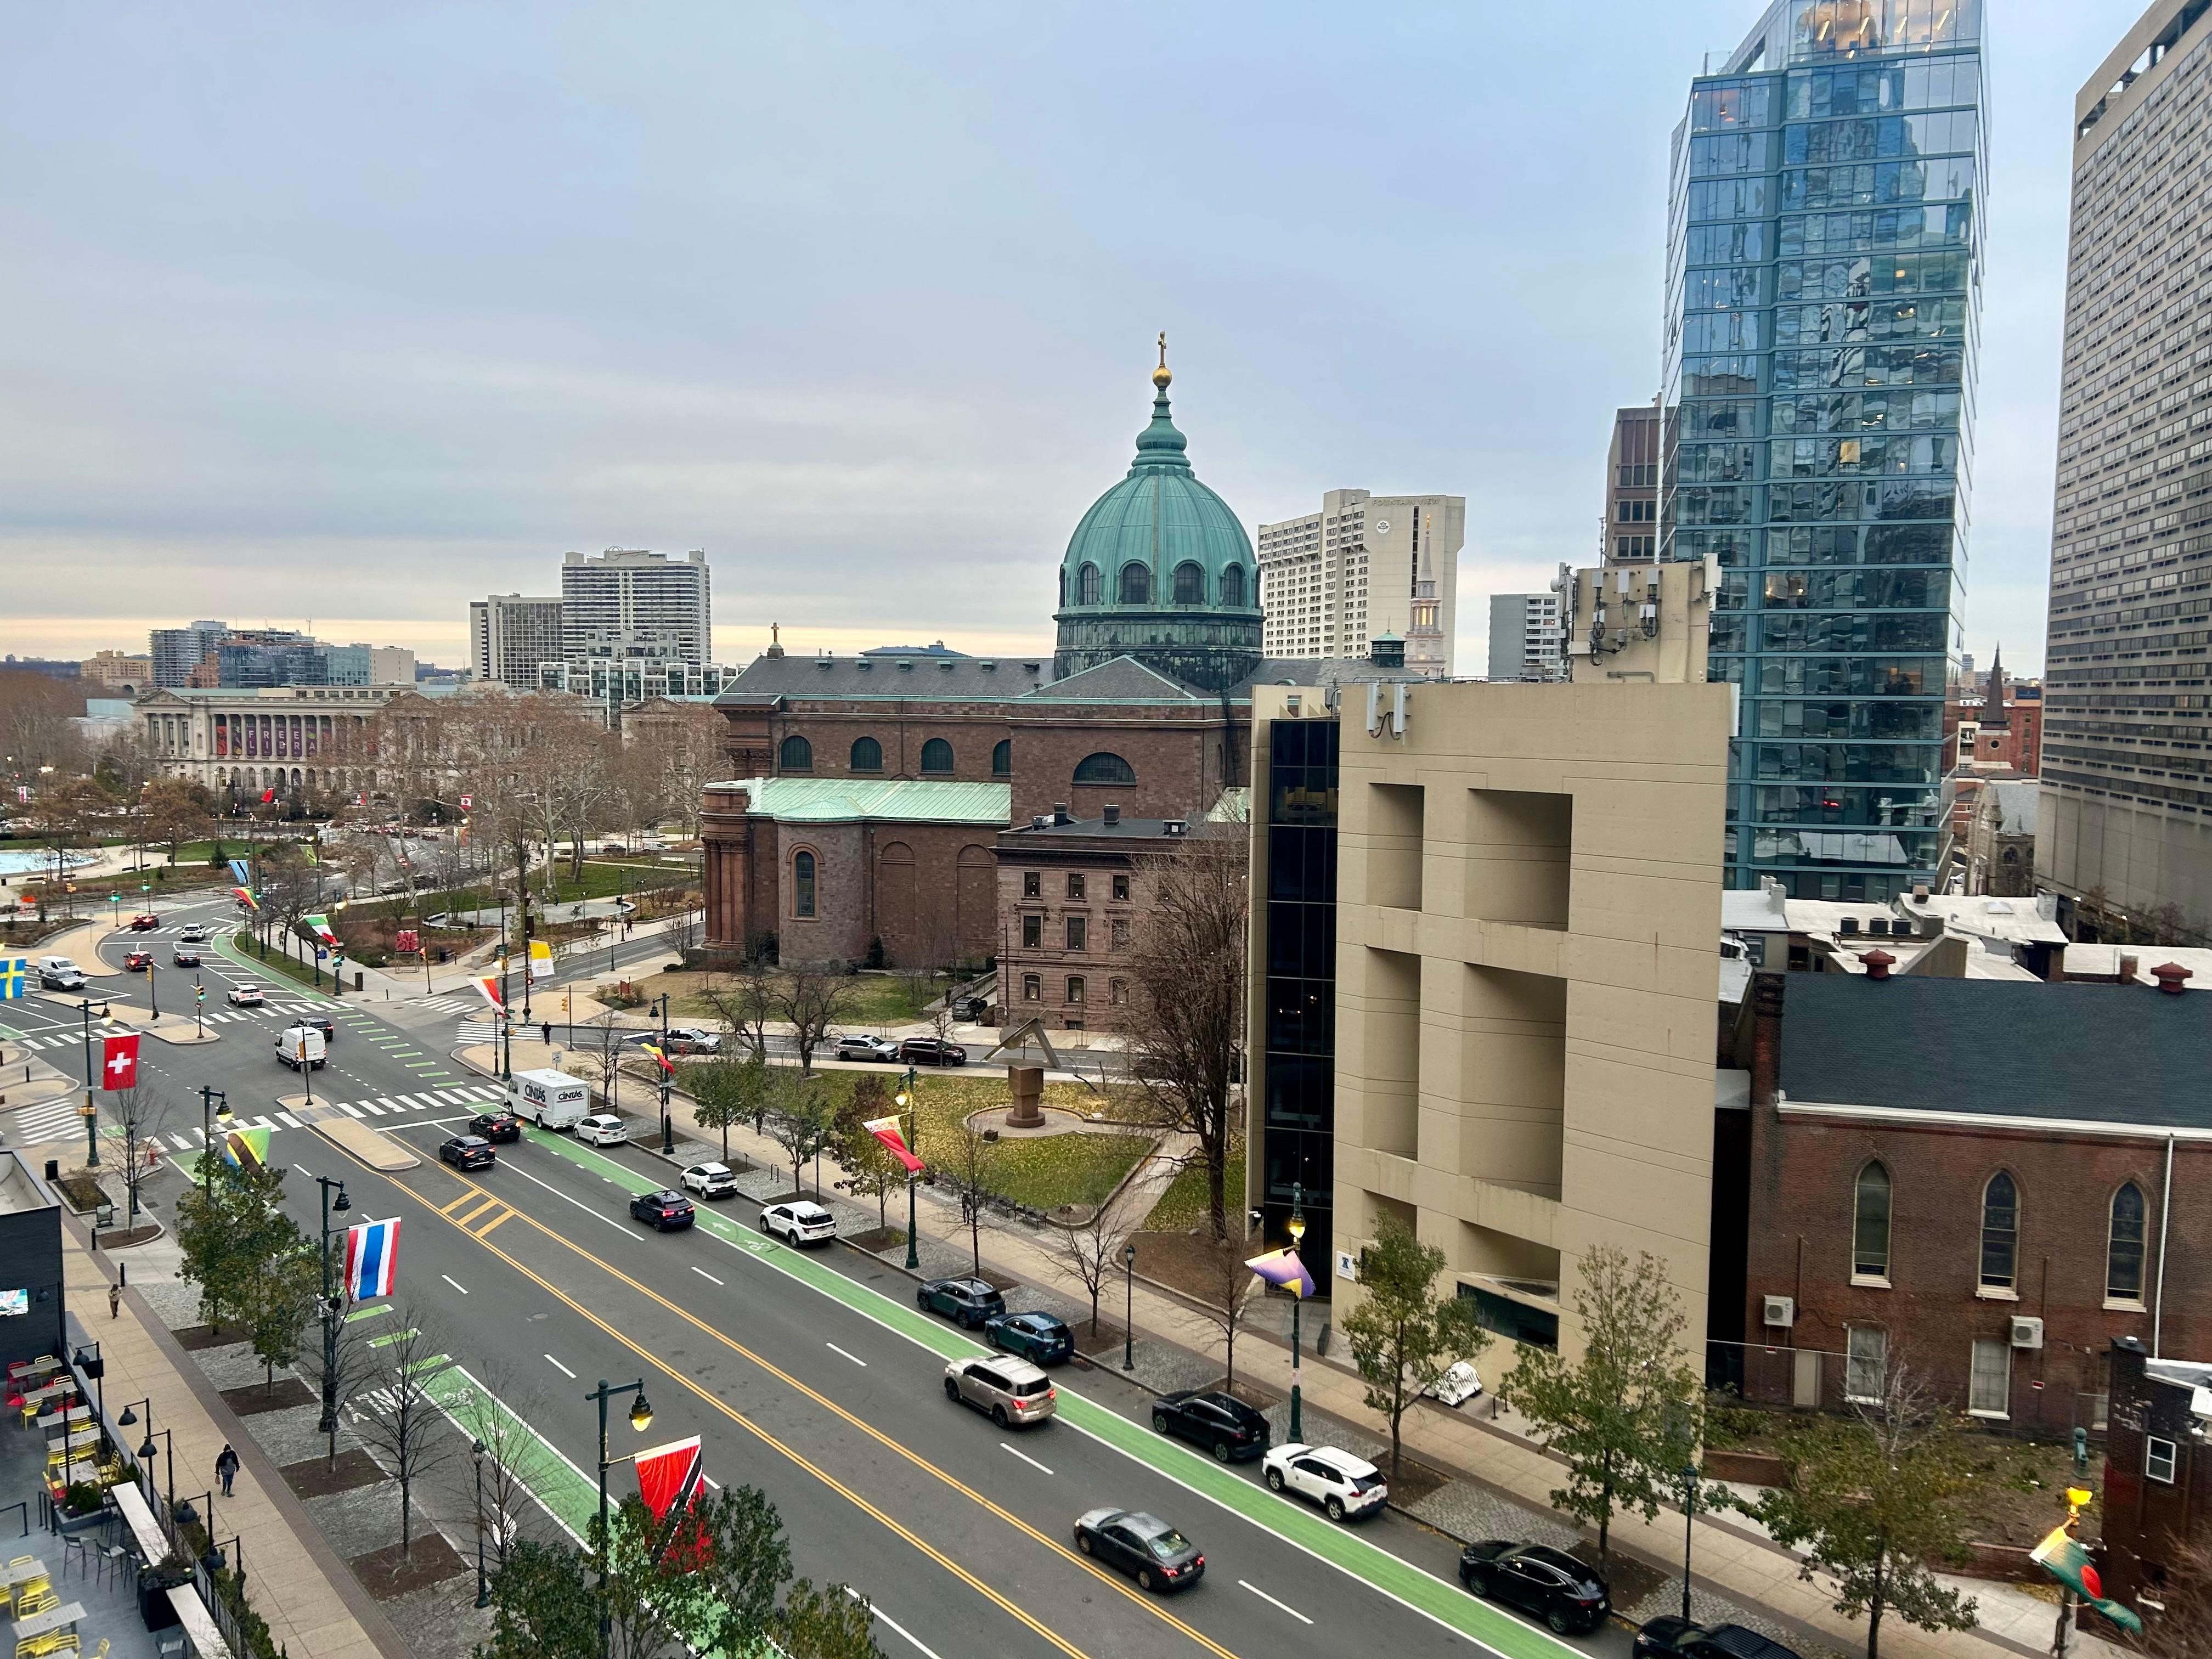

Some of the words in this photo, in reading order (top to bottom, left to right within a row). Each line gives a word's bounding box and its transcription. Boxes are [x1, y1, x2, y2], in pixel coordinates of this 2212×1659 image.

[249, 730, 300, 740] FREE
[525, 1081, 546, 1102] CINTAS
[558, 1090, 583, 1100] CINTAS
